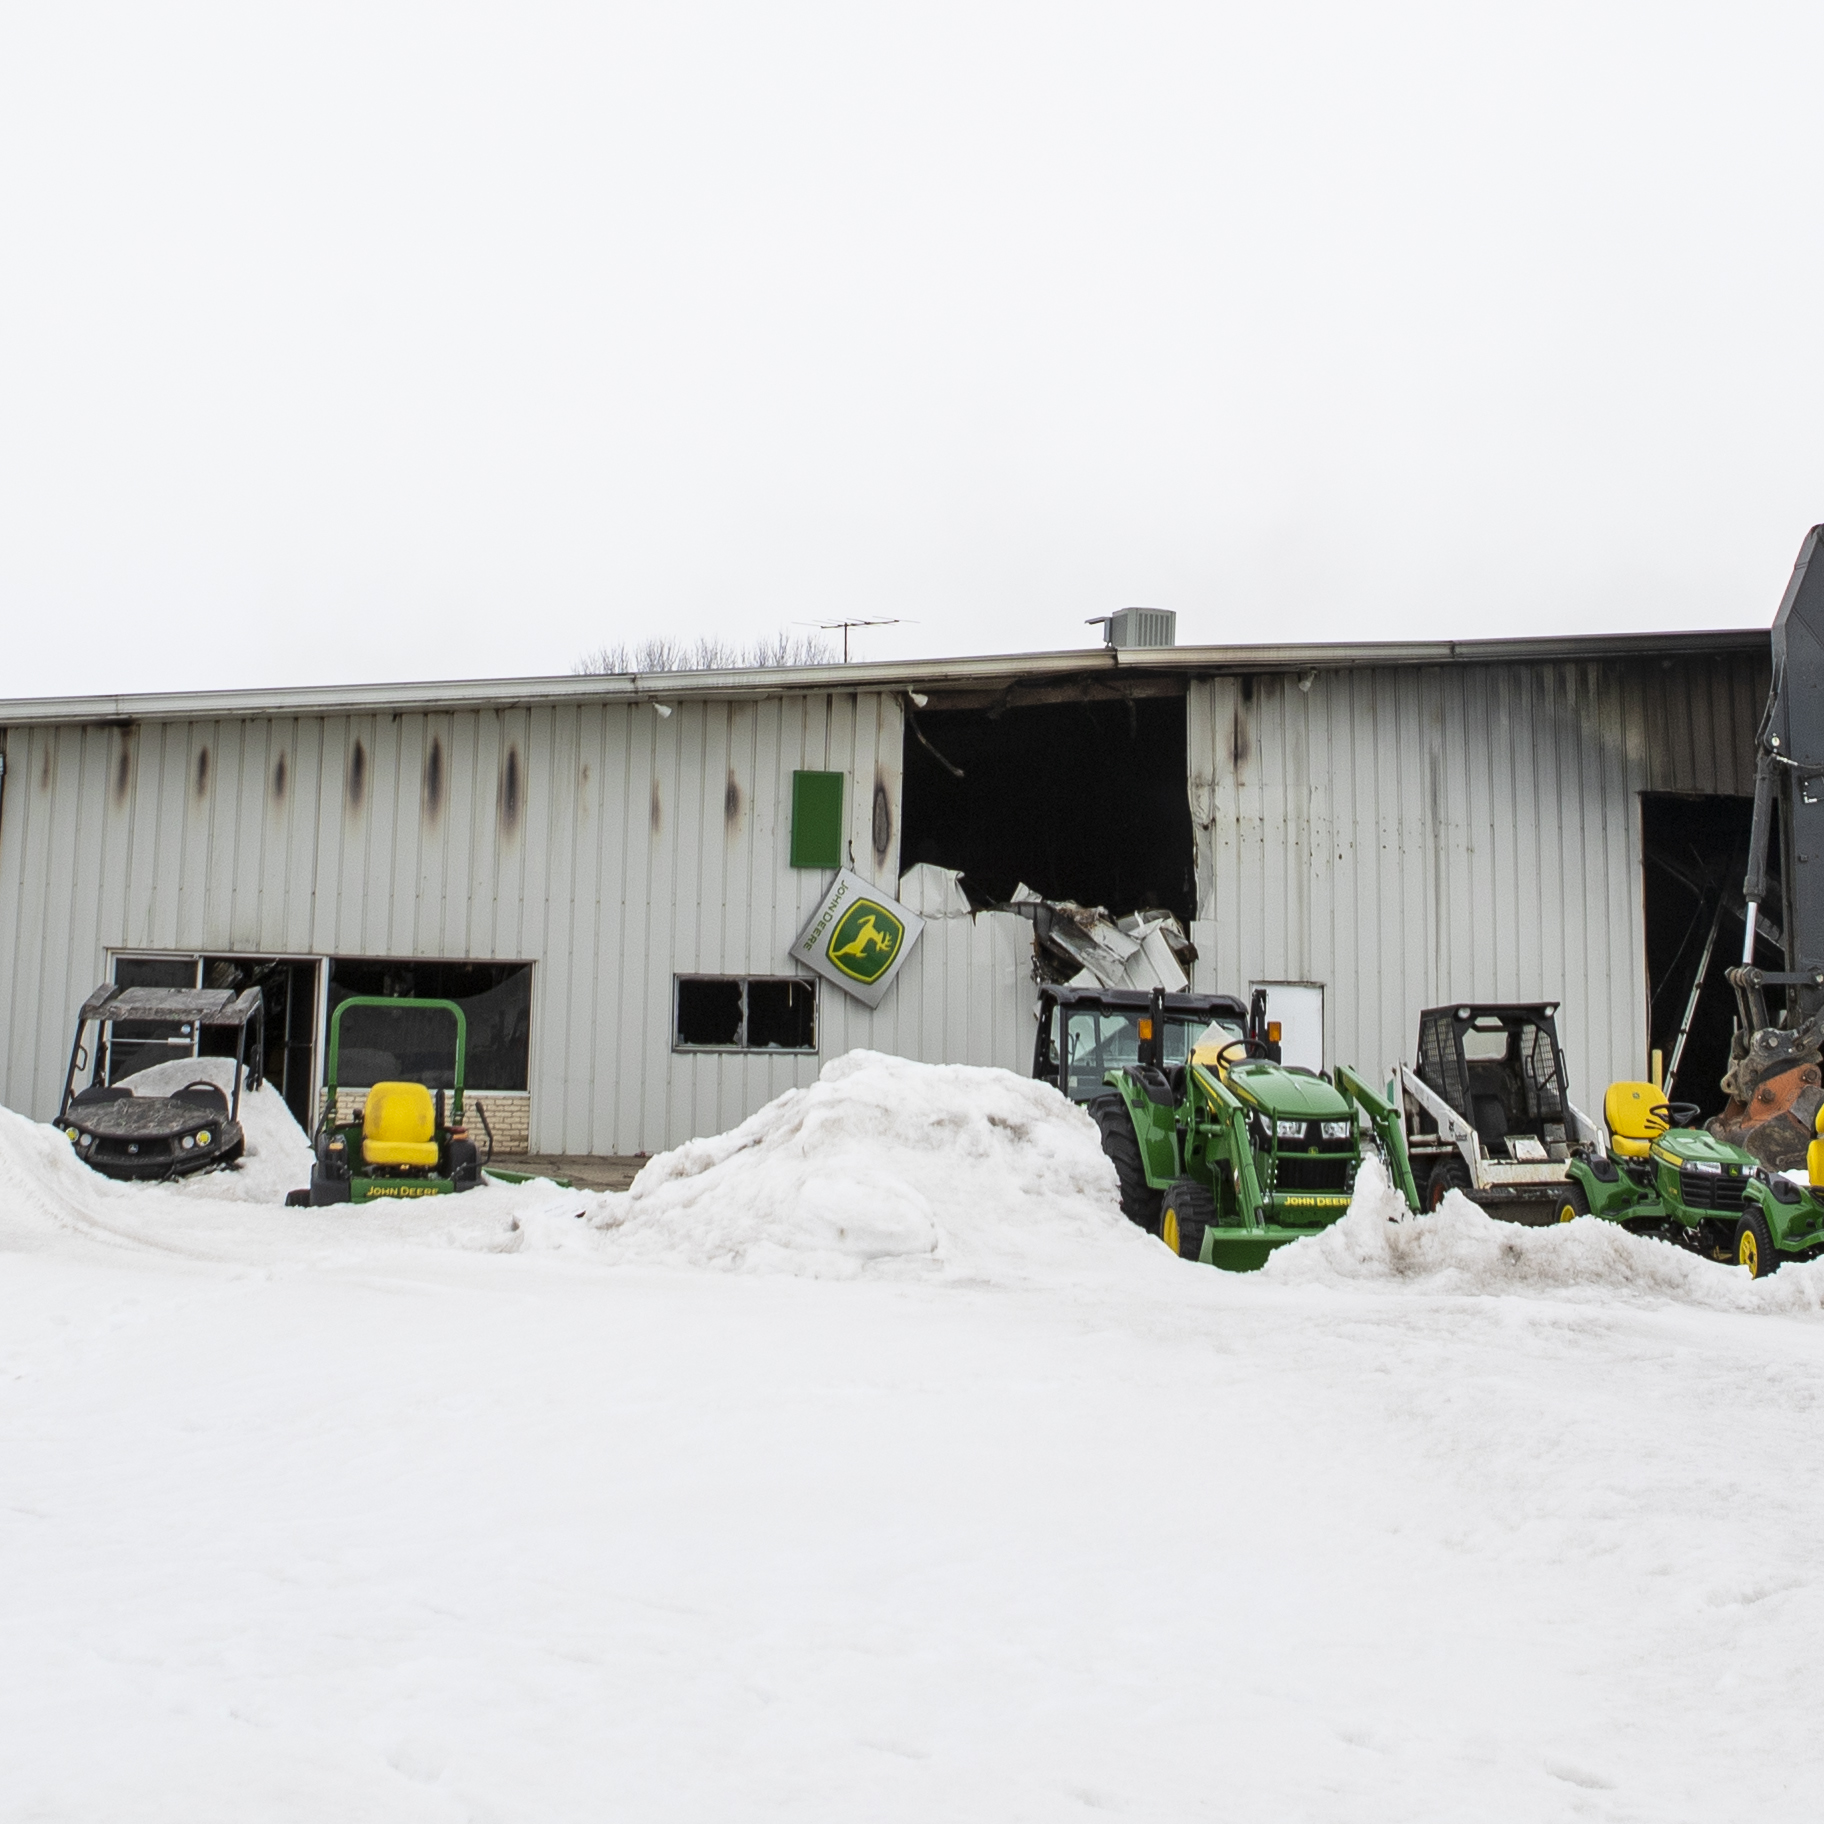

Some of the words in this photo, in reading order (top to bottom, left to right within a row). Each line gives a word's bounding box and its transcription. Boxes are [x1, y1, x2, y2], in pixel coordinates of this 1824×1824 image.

[828, 879, 849, 912] JOHN
[803, 911, 833, 951] DEERE
[366, 1185, 398, 1196] JOHN
[1284, 1196, 1315, 1207] JOHN
[1317, 1196, 1352, 1207] DEER
